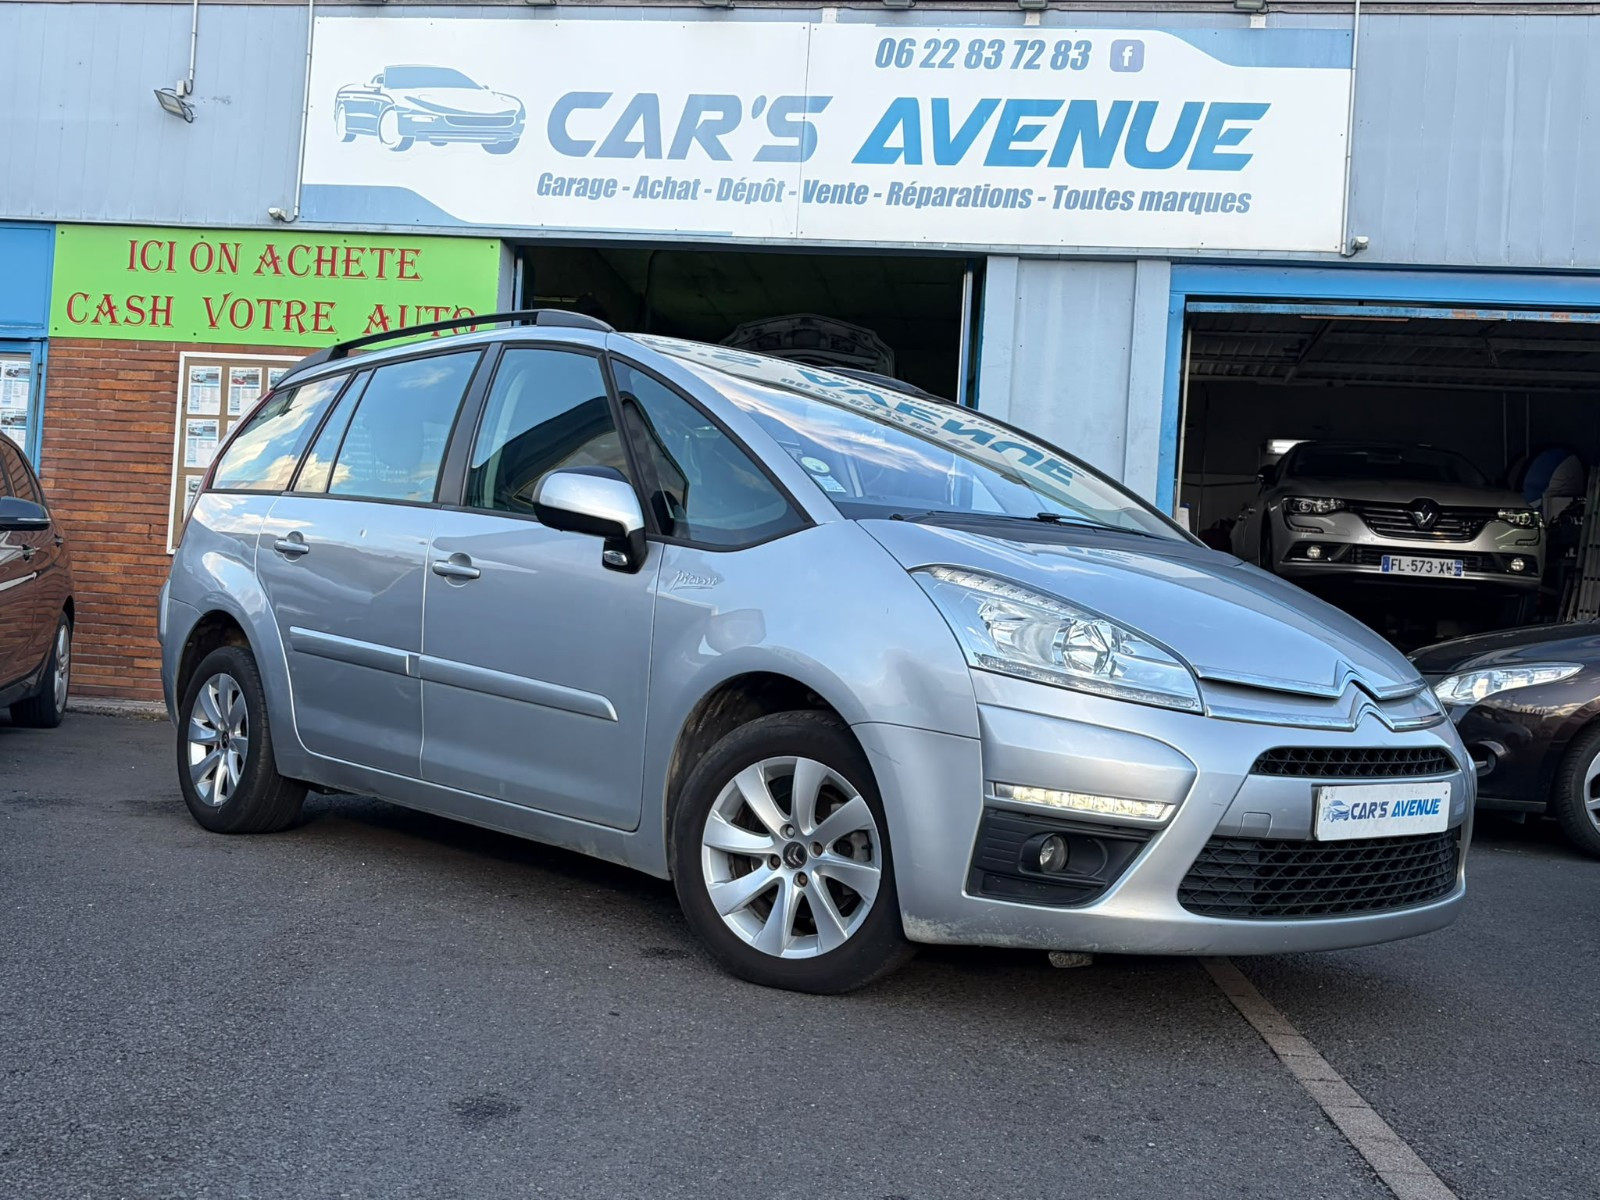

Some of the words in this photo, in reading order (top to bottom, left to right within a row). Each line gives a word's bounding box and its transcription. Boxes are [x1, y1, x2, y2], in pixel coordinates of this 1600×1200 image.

[875, 38, 917, 68] 06
[919, 38, 960, 68] 22
[964, 39, 1005, 69] 83
[1010, 39, 1046, 70] 72
[1050, 40, 1092, 70] 83
[547, 91, 834, 163] CAR'S
[851, 97, 1272, 171] AVENUE
[537, 172, 618, 200] Garage
[633, 175, 701, 200] Achat
[716, 177, 786, 204] Dépôt
[802, 180, 869, 205] Vente
[886, 181, 1034, 209] Réparations
[1052, 185, 1133, 211] Toutes
[1138, 189, 1252, 215] marques
[127, 239, 176, 273] ICI
[189, 241, 242, 275] ON
[253, 243, 422, 281] ACHETE
[66, 291, 174, 328] CASH
[202, 291, 337, 335] VOTRE
[362, 303, 479, 337] AUTO
[1351, 801, 1389, 819] CAR'S
[1391, 798, 1441, 817] AVENUE
